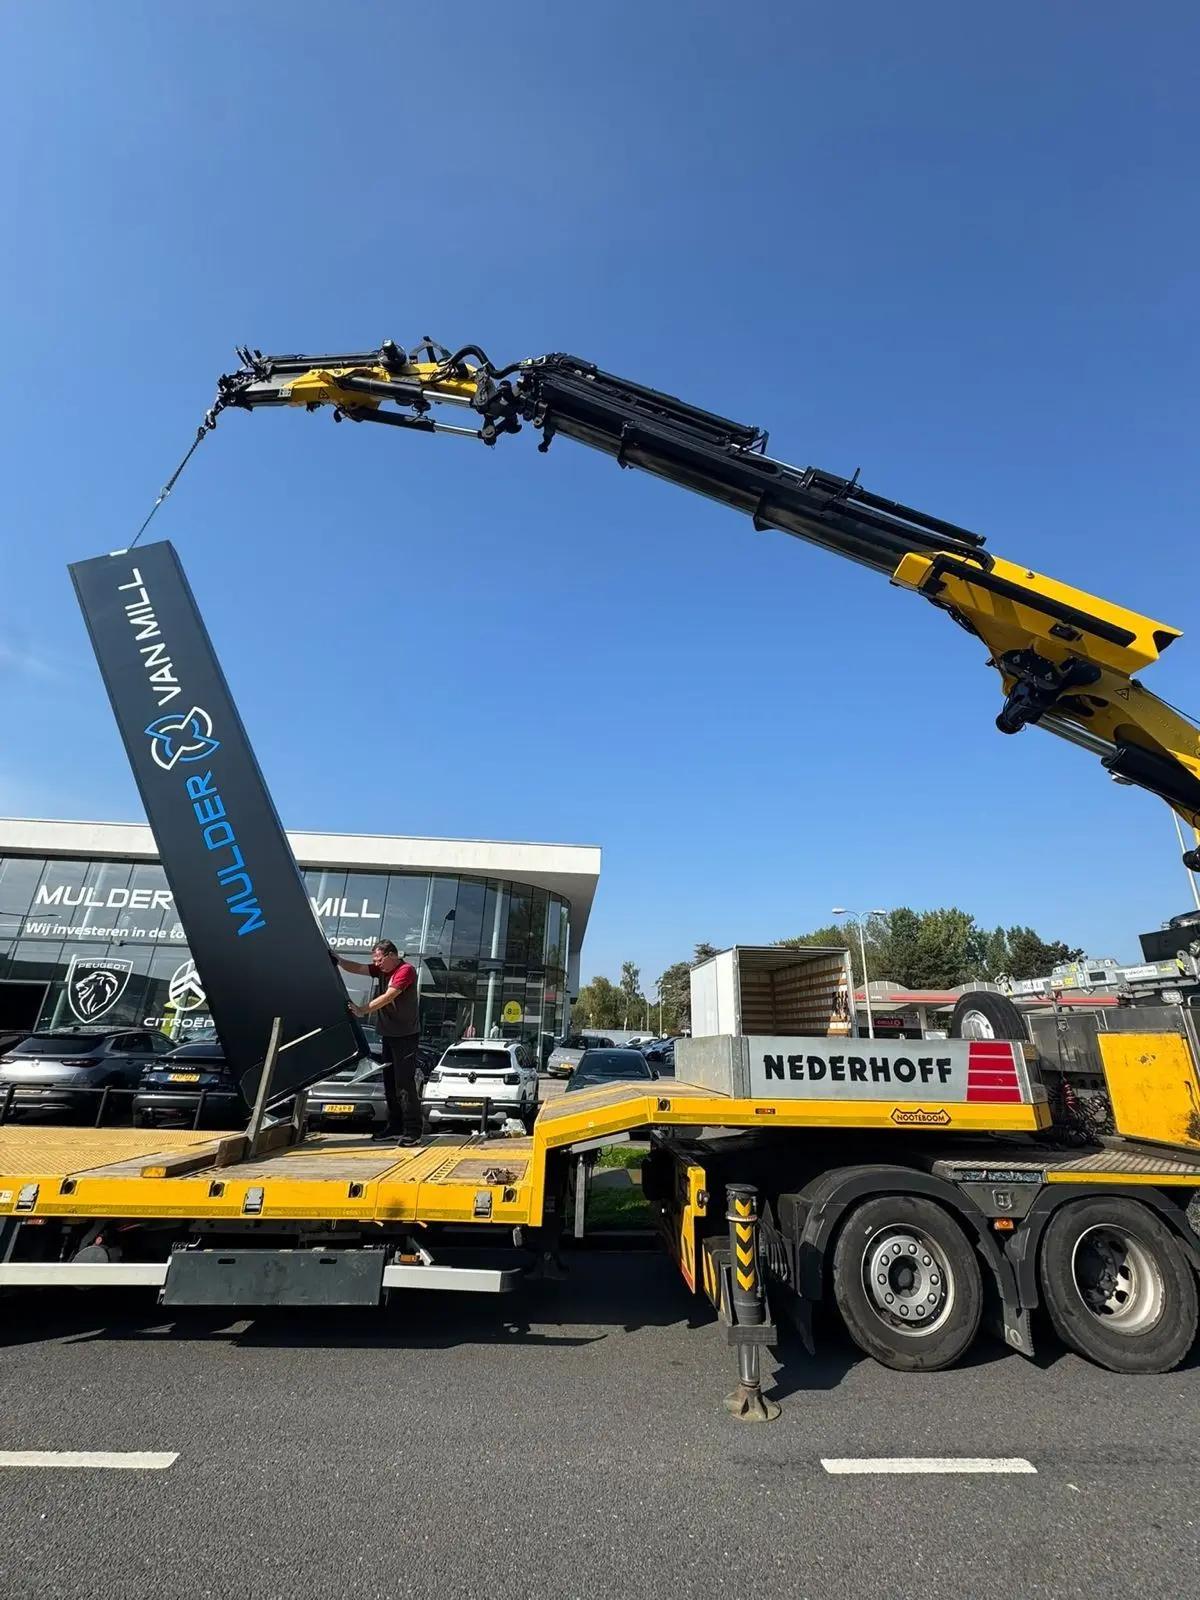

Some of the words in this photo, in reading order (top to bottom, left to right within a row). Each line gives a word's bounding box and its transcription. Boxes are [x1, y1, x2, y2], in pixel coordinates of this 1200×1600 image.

[117, 567, 162, 641] MILL
[140, 642, 182, 707] VAN
[185, 769, 267, 937] MULDER
[34, 884, 175, 910] MULDER
[25, 922, 50, 937] Wij
[52, 925, 129, 938] investeren
[131, 926, 146, 938] in
[148, 927, 167, 939] de
[169, 929, 188, 940] to
[327, 936, 378, 948] opend!
[77, 962, 129, 971] PEUGEOT
[763, 1053, 952, 1084] NEDERHOFF
[896, 1113, 945, 1122] NOOTEBOOM
